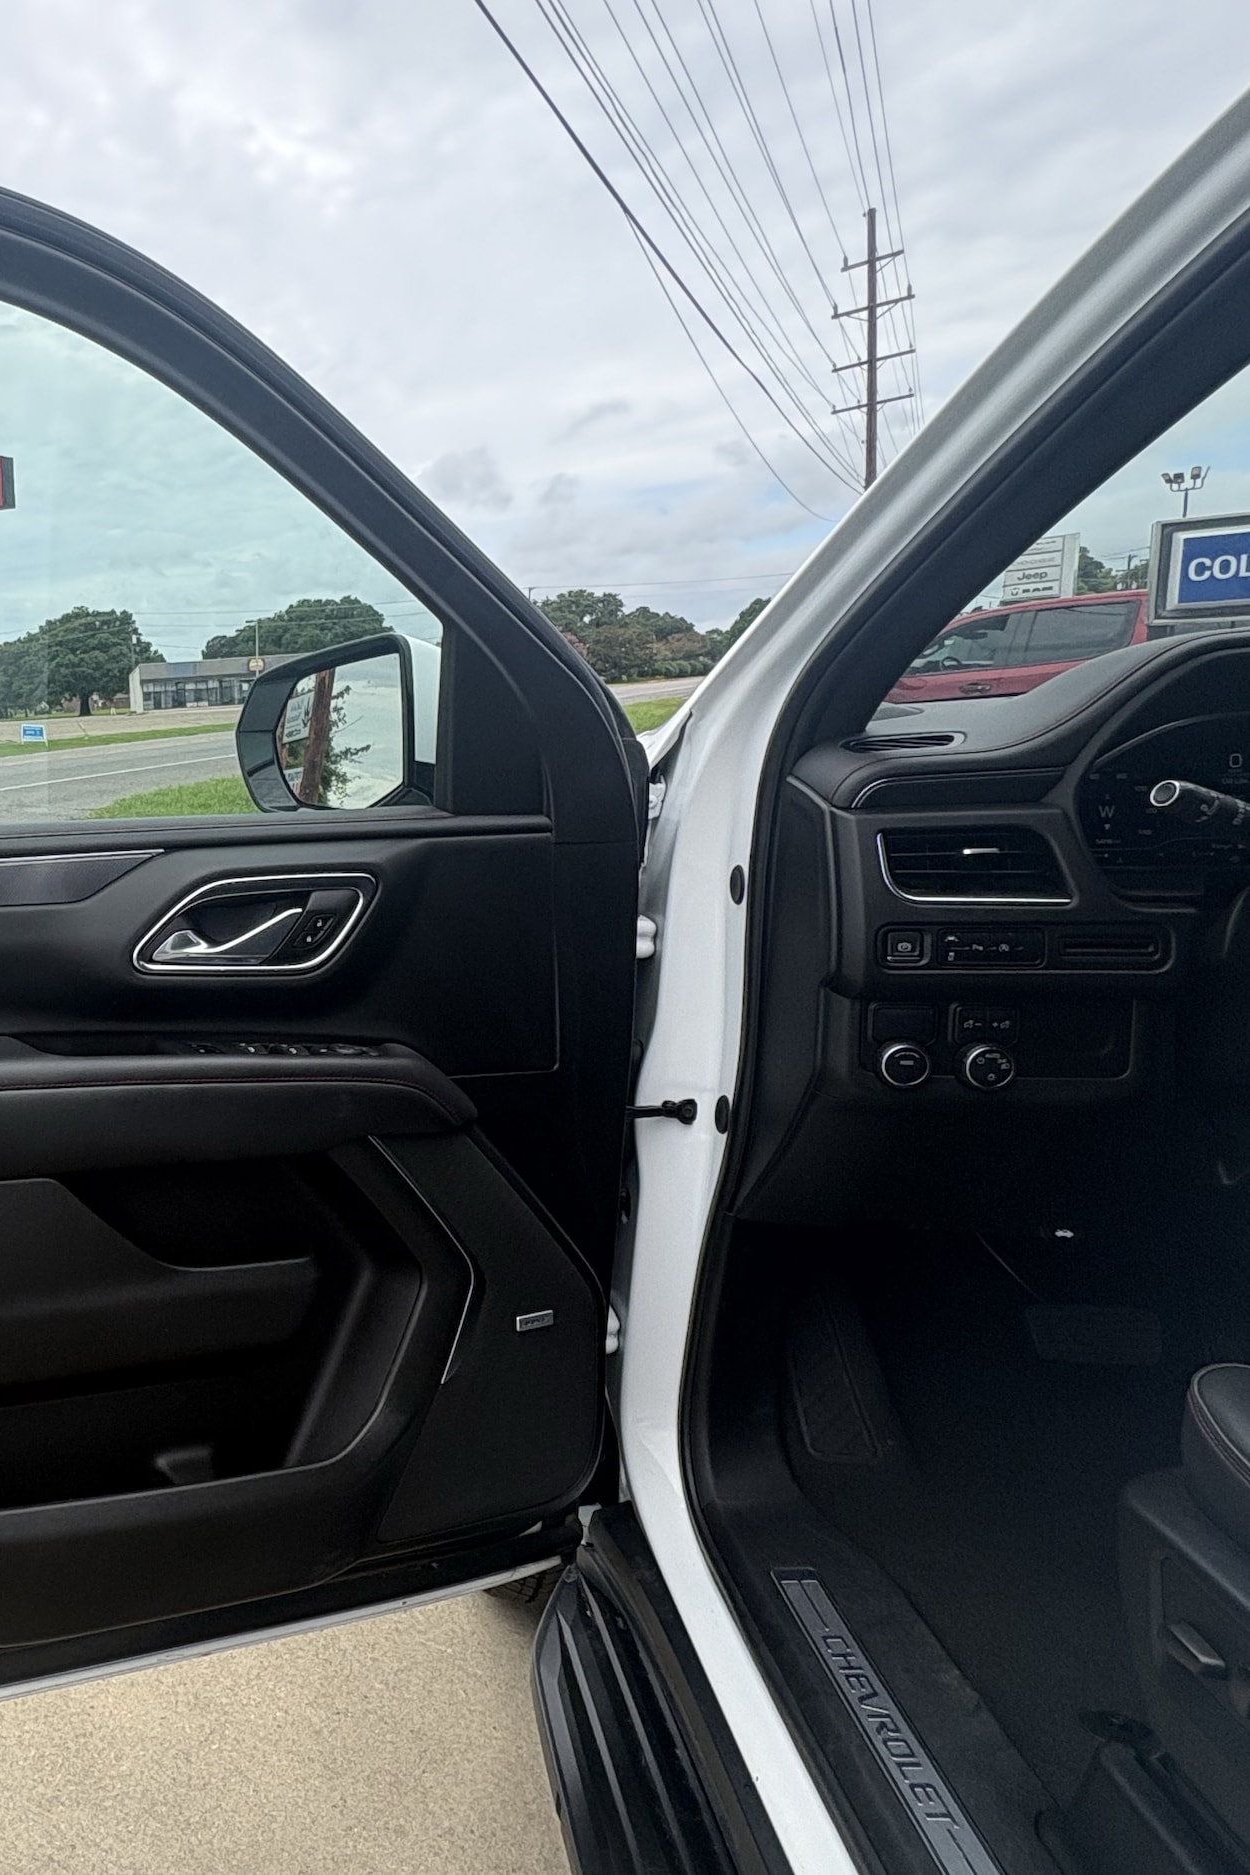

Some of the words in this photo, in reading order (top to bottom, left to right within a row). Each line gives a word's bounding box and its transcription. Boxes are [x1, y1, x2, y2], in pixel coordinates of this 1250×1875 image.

[1017, 571, 1048, 581] Jeep
[1098, 804, 1115, 819] W
[821, 1635, 960, 1829] CHEVROLET
